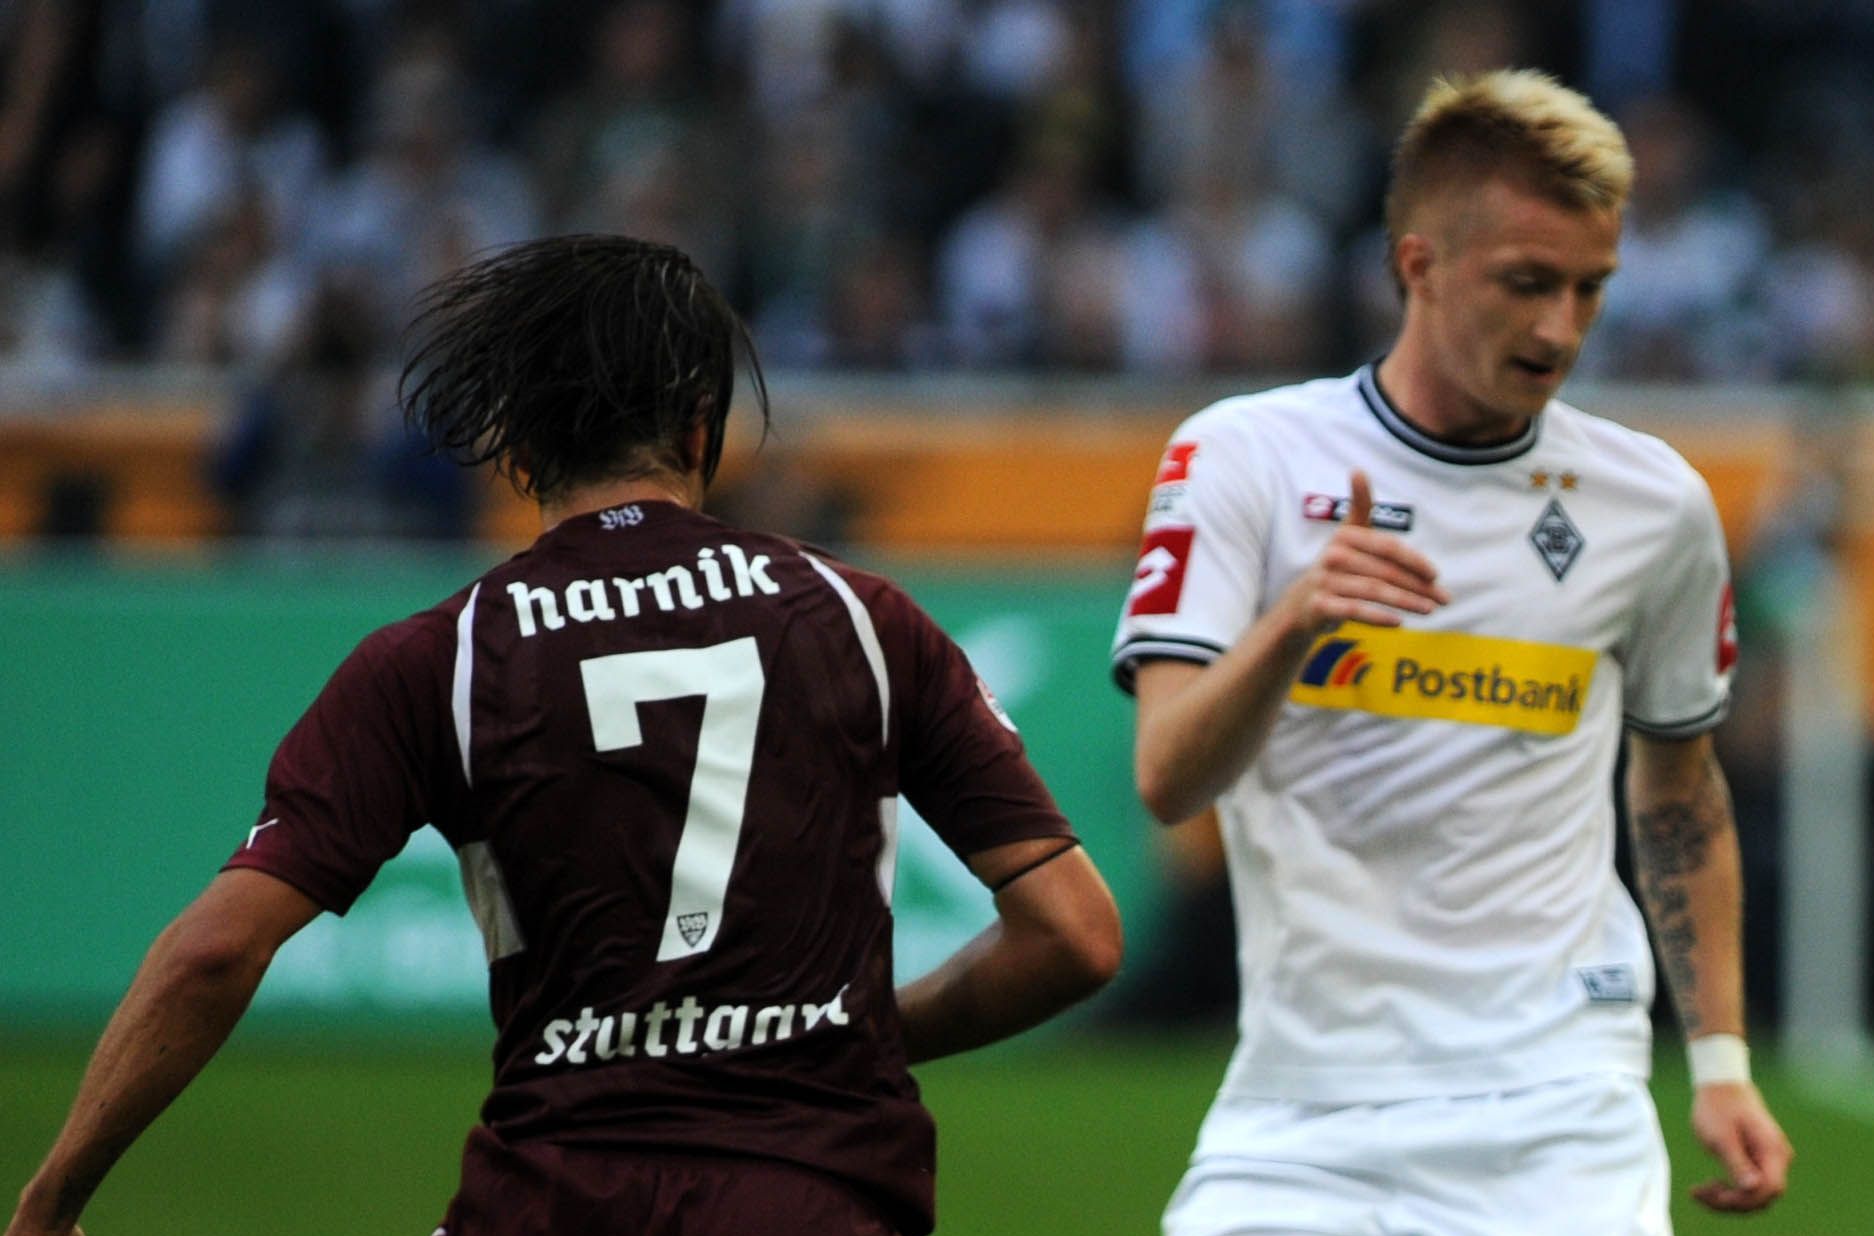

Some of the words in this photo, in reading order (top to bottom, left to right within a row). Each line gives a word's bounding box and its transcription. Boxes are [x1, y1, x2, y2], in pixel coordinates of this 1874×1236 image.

[506, 544, 781, 638] harnik
[1393, 656, 1581, 713] Postbank
[580, 637, 765, 961] 7
